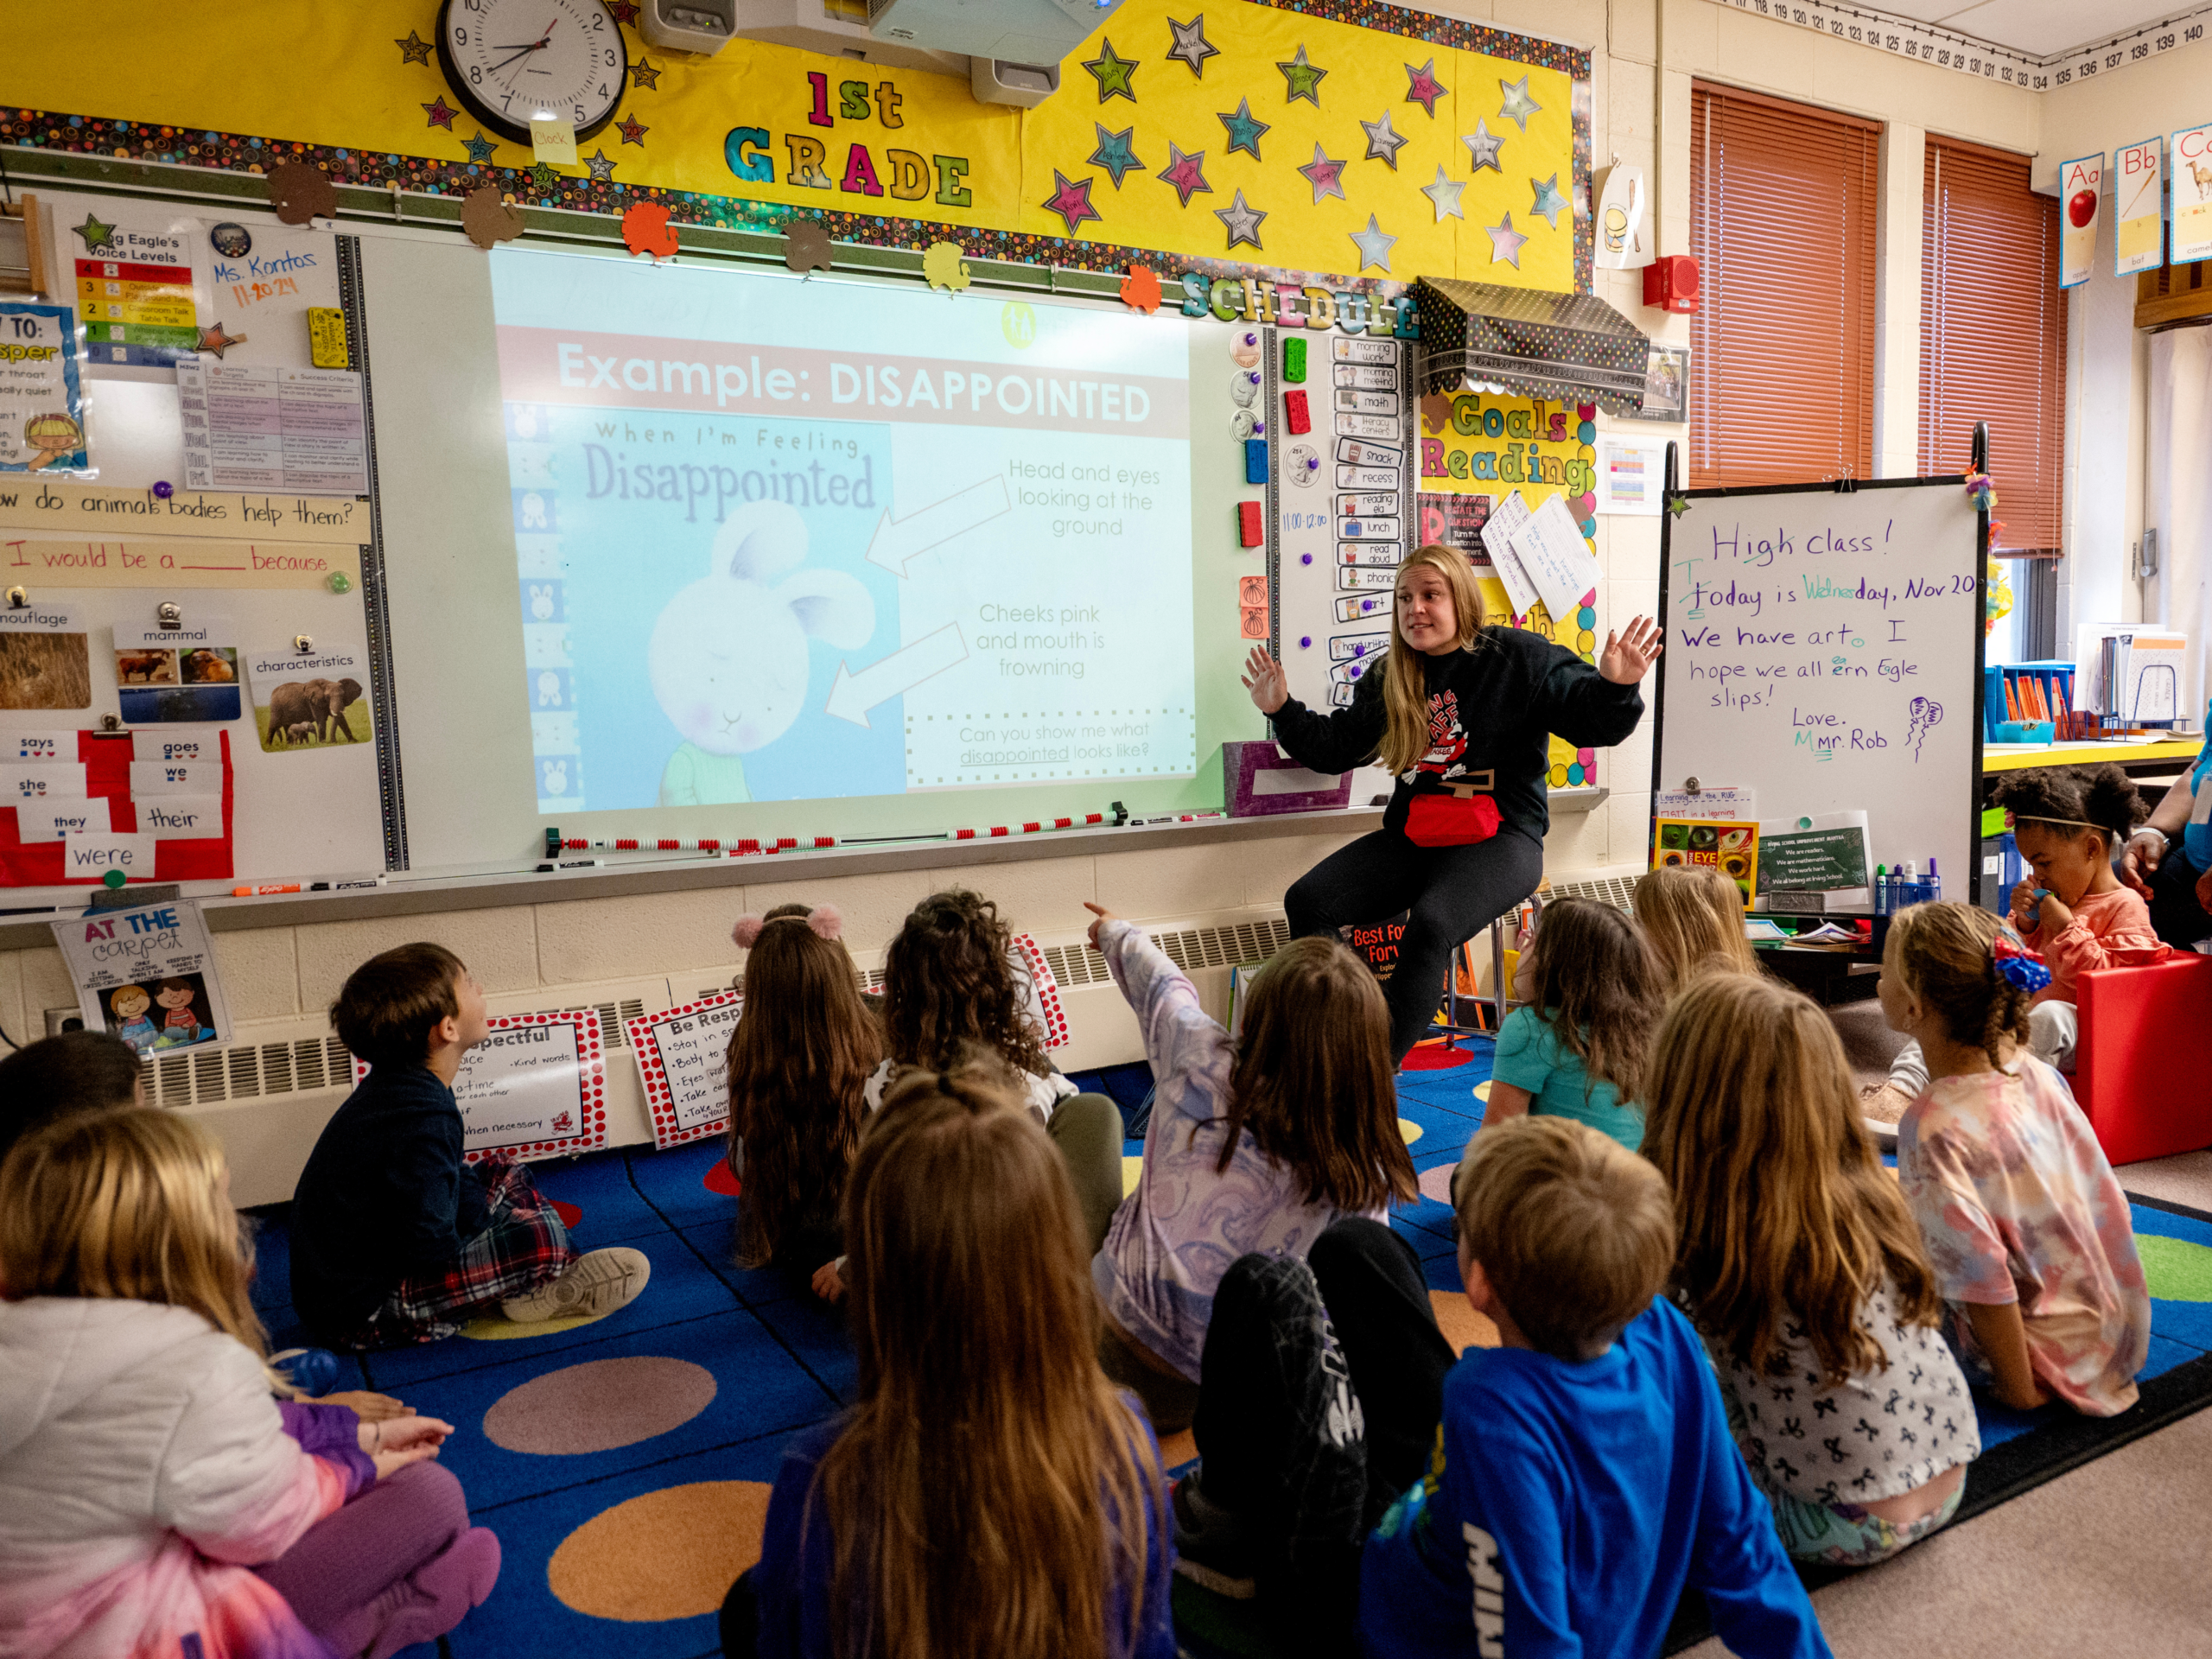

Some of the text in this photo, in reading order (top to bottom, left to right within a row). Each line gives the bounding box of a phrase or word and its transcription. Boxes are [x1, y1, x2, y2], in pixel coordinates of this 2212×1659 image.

[455, 14, 604, 46] 9 2
[1792, 9, 2203, 88] 120 122 124 125 134 136 138 140
[470, 49, 616, 85] 8 3
[500, 83, 609, 122] 7 5 4
[807, 71, 904, 129] 1st
[534, 131, 568, 145] Clock
[724, 126, 971, 207] GRADE
[2126, 146, 2155, 175] Bb
[2068, 164, 2099, 188] Aa
[129, 234, 180, 248] Eagle's
[131, 250, 177, 263] Levels
[2132, 255, 2145, 266] bat
[214, 262, 245, 283] Ms.
[2072, 270, 2088, 280] apple
[86, 282, 93, 292] 3
[88, 303, 97, 314] 2
[128, 304, 171, 314] Classroom
[1180, 271, 1420, 340] SCHEDULE
[10, 318, 42, 339] TO:
[1357, 342, 1389, 354] morning
[1363, 353, 1384, 362] work
[1363, 368, 1393, 378] morning
[557, 343, 1150, 422] Example: DISAPPOINTED
[1364, 378, 1393, 388] meeting
[1365, 396, 1389, 408] math
[1362, 416, 1389, 429] literacy
[1452, 394, 1566, 442] Goals
[1362, 427, 1389, 435] centers
[596, 422, 858, 459] When I'm Feeling
[1367, 450, 1393, 465] snack
[1009, 459, 1160, 486] Head and eyes
[1421, 437, 1588, 497] Reading
[582, 443, 876, 523] Disappointed
[1363, 474, 1393, 483] recess
[36, 485, 353, 526] do bodies help them?
[1019, 486, 1153, 512] looking at the
[1374, 505, 1384, 513] ela
[1445, 506, 1486, 515] RESTATE THE
[1052, 518, 1122, 537] ground
[1367, 521, 1389, 532] lunch
[1448, 518, 1484, 527] QUESTION
[1370, 544, 1389, 553] read
[1713, 522, 1793, 567] High
[6, 539, 328, 571] I would be a because
[1369, 554, 1390, 563] aloud
[1777, 586, 1796, 603] is
[1904, 577, 1946, 599] Nov
[980, 604, 1100, 626] Cheeks pink
[143, 629, 207, 641] mammal
[1738, 627, 1796, 645] have
[1888, 620, 1906, 642] I
[976, 632, 1105, 649] and mouth is
[256, 655, 353, 672] characteristics
[999, 658, 1084, 679] frowning
[1690, 660, 1747, 685] hope
[1756, 662, 1788, 677] we
[1797, 660, 1821, 677] all
[1711, 684, 1773, 711] slips!
[960, 722, 1149, 743] Can you show me what
[1851, 728, 1887, 749] Rob
[21, 738, 54, 748] says
[163, 741, 199, 755] goes
[961, 743, 1149, 766] disappointed looks like?
[165, 767, 187, 776] we
[19, 779, 47, 790] she
[1661, 793, 1688, 805] Learning
[147, 807, 199, 828] their
[1708, 810, 1735, 819] learning
[54, 817, 86, 828] they
[74, 849, 133, 865] were
[1694, 852, 1716, 862] EYE
[85, 908, 180, 943] AT THE
[1354, 926, 1383, 947] Best
[671, 1021, 694, 1035] Be
[672, 1039, 697, 1051] Stay
[543, 1053, 570, 1065] words
[676, 1054, 703, 1068] Body
[681, 1074, 703, 1087] Eyes
[683, 1090, 707, 1103] Take
[493, 1120, 543, 1132] necessary
